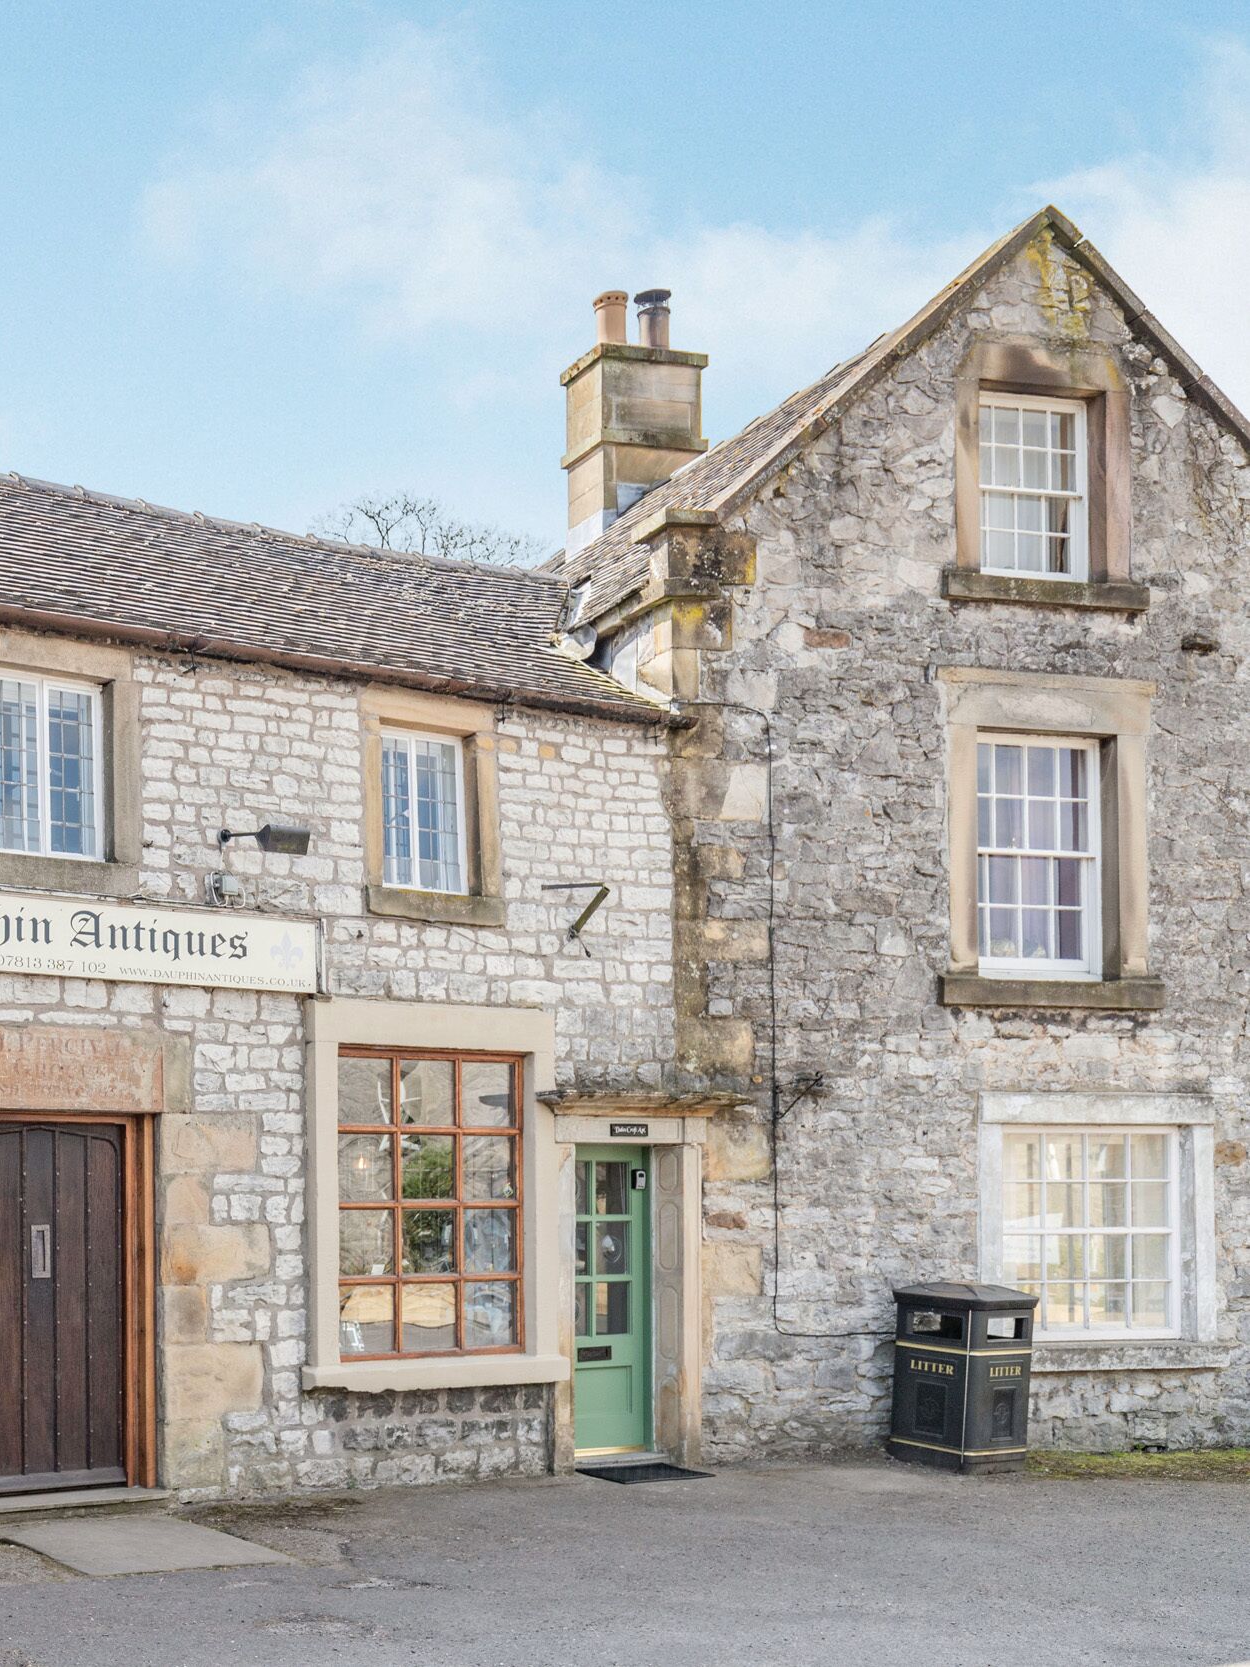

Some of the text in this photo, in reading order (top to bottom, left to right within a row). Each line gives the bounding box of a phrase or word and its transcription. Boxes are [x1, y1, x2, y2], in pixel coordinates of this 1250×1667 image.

[70, 910, 249, 962] Antiques
[47, 958, 75, 971] 387
[81, 962, 107, 974] 102
[910, 1359, 954, 1376] LITTER
[989, 1365, 1022, 1377] LITTER
